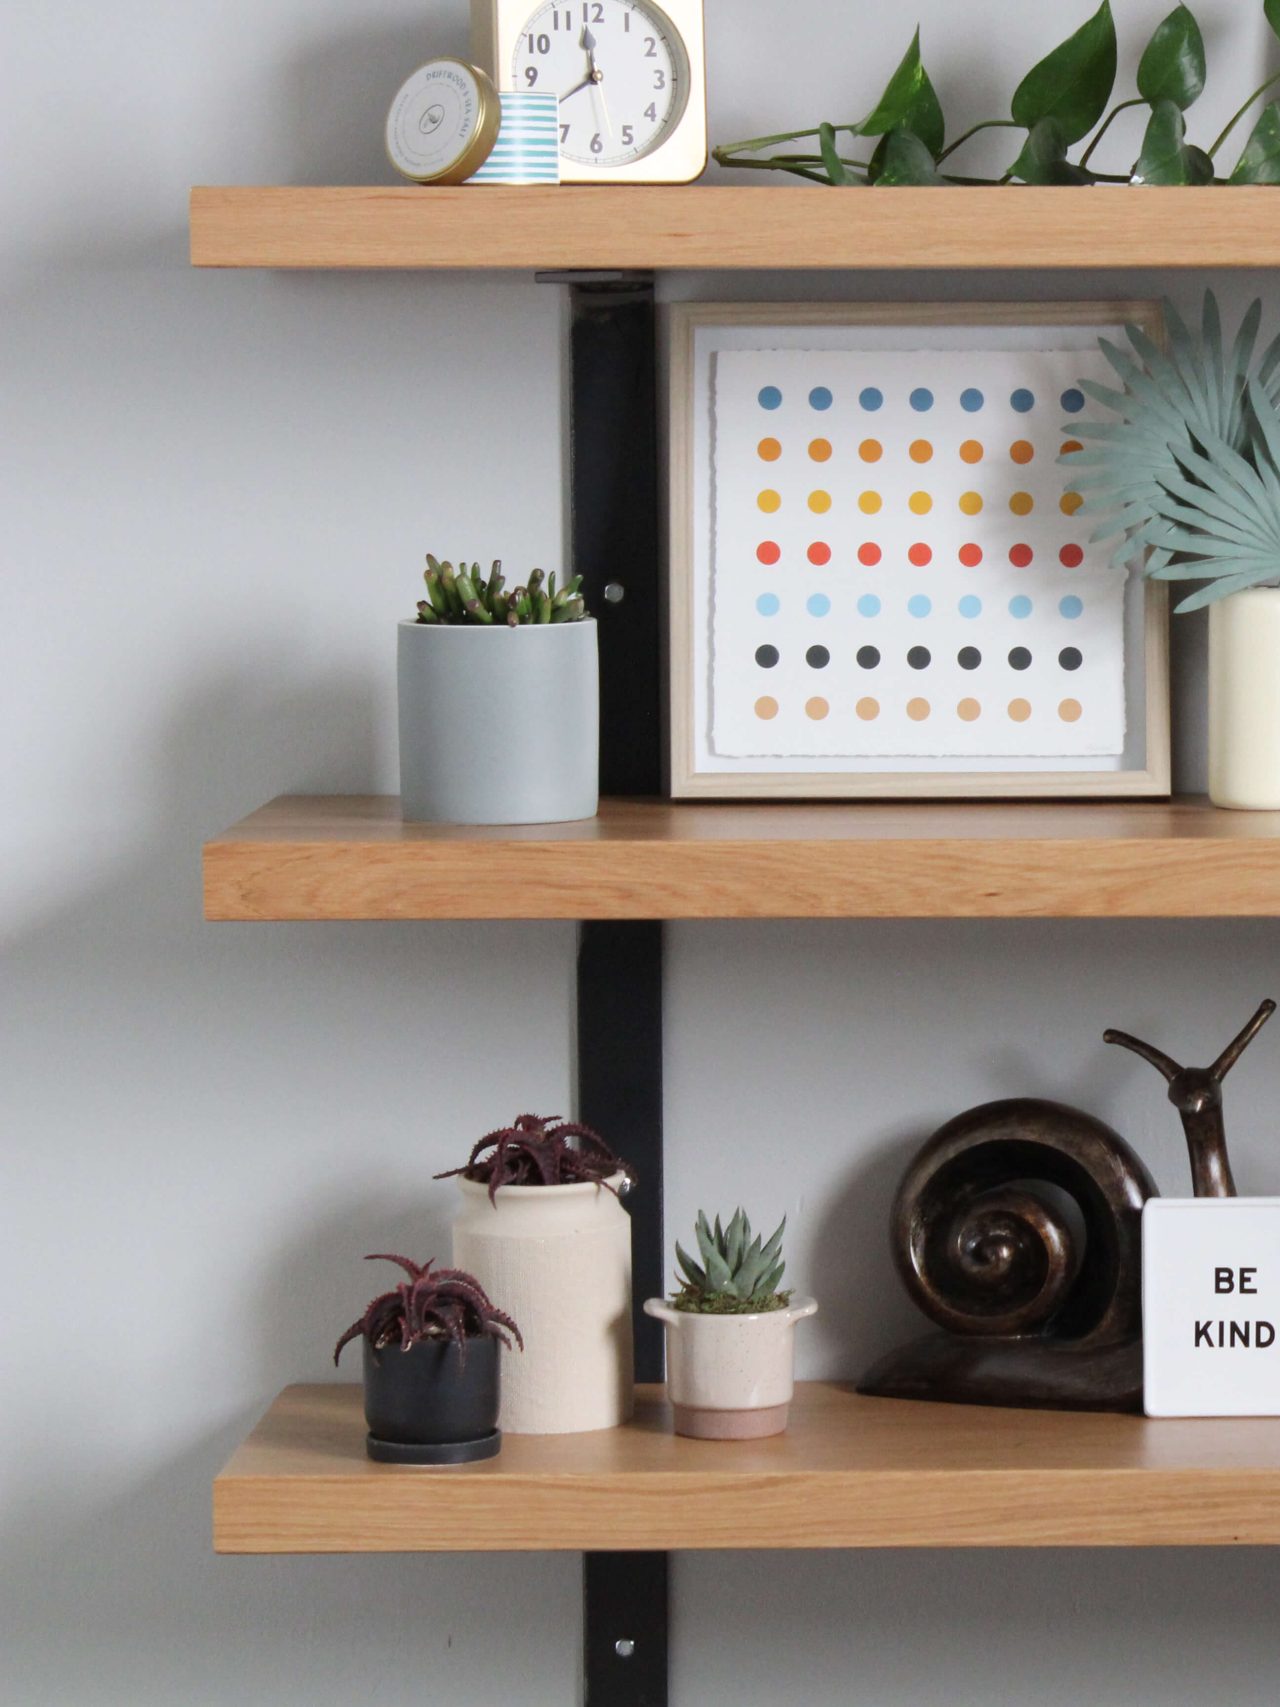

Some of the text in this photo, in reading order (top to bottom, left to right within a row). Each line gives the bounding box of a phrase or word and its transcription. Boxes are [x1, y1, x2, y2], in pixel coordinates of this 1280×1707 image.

[553, 10, 572, 31] 11
[583, 2, 604, 23] 12
[624, 12, 630, 33] 1
[528, 33, 551, 55] 10
[643, 37, 657, 57] 2
[525, 66, 539, 87] 9
[653, 69, 665, 90] 3
[643, 102, 656, 122] 4
[559, 124, 570, 144] 7
[590, 132, 602, 153] 6
[621, 125, 633, 145] 5
[1214, 1267, 1258, 1294] BE
[1194, 1320, 1275, 1348] KIND
